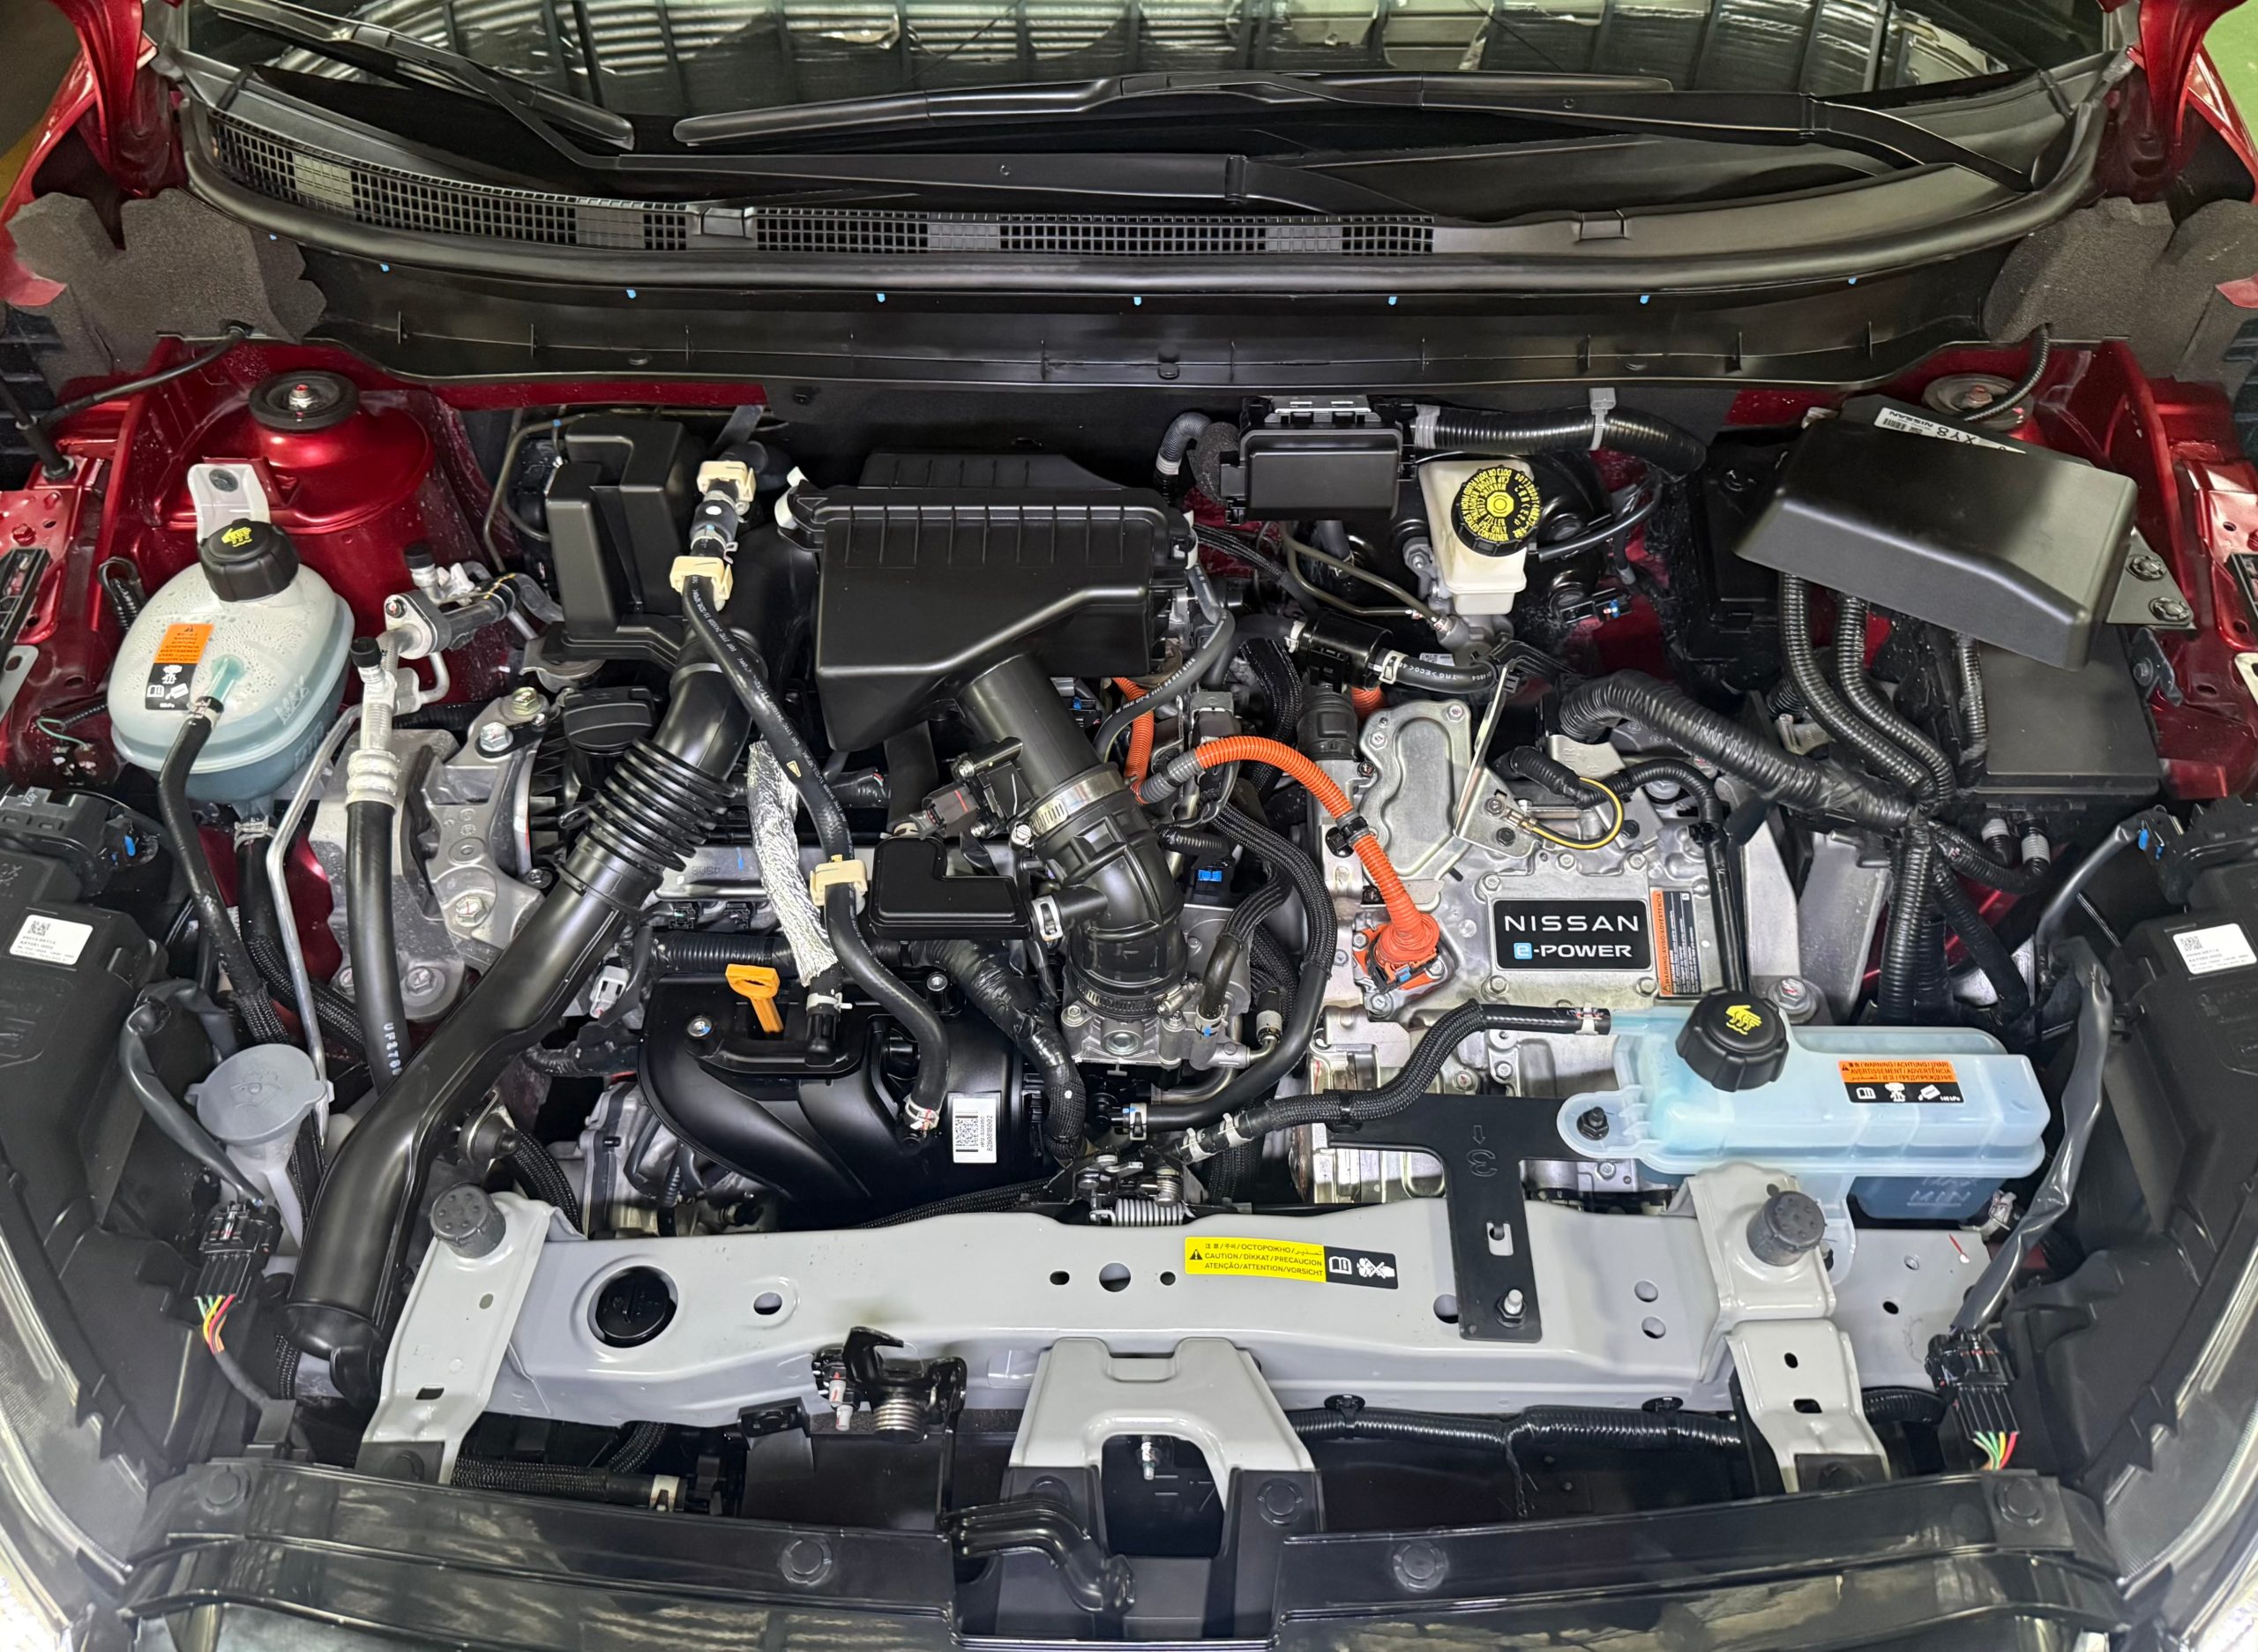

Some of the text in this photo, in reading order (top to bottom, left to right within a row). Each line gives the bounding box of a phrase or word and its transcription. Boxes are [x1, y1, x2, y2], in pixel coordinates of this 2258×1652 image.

[1889, 411, 1934, 428] NISSAN
[1487, 468, 1497, 477] OR
[1497, 467, 1513, 476] DOT3
[1475, 476, 1497, 491] BEFORE
[1478, 520, 1491, 532] USE
[1484, 514, 1507, 527] FILLER
[1477, 529, 1510, 542] CONTAINER
[1491, 526, 1507, 534] ONLY
[1505, 915, 1640, 932] NISSAN
[1515, 944, 1633, 959] e-POWER
